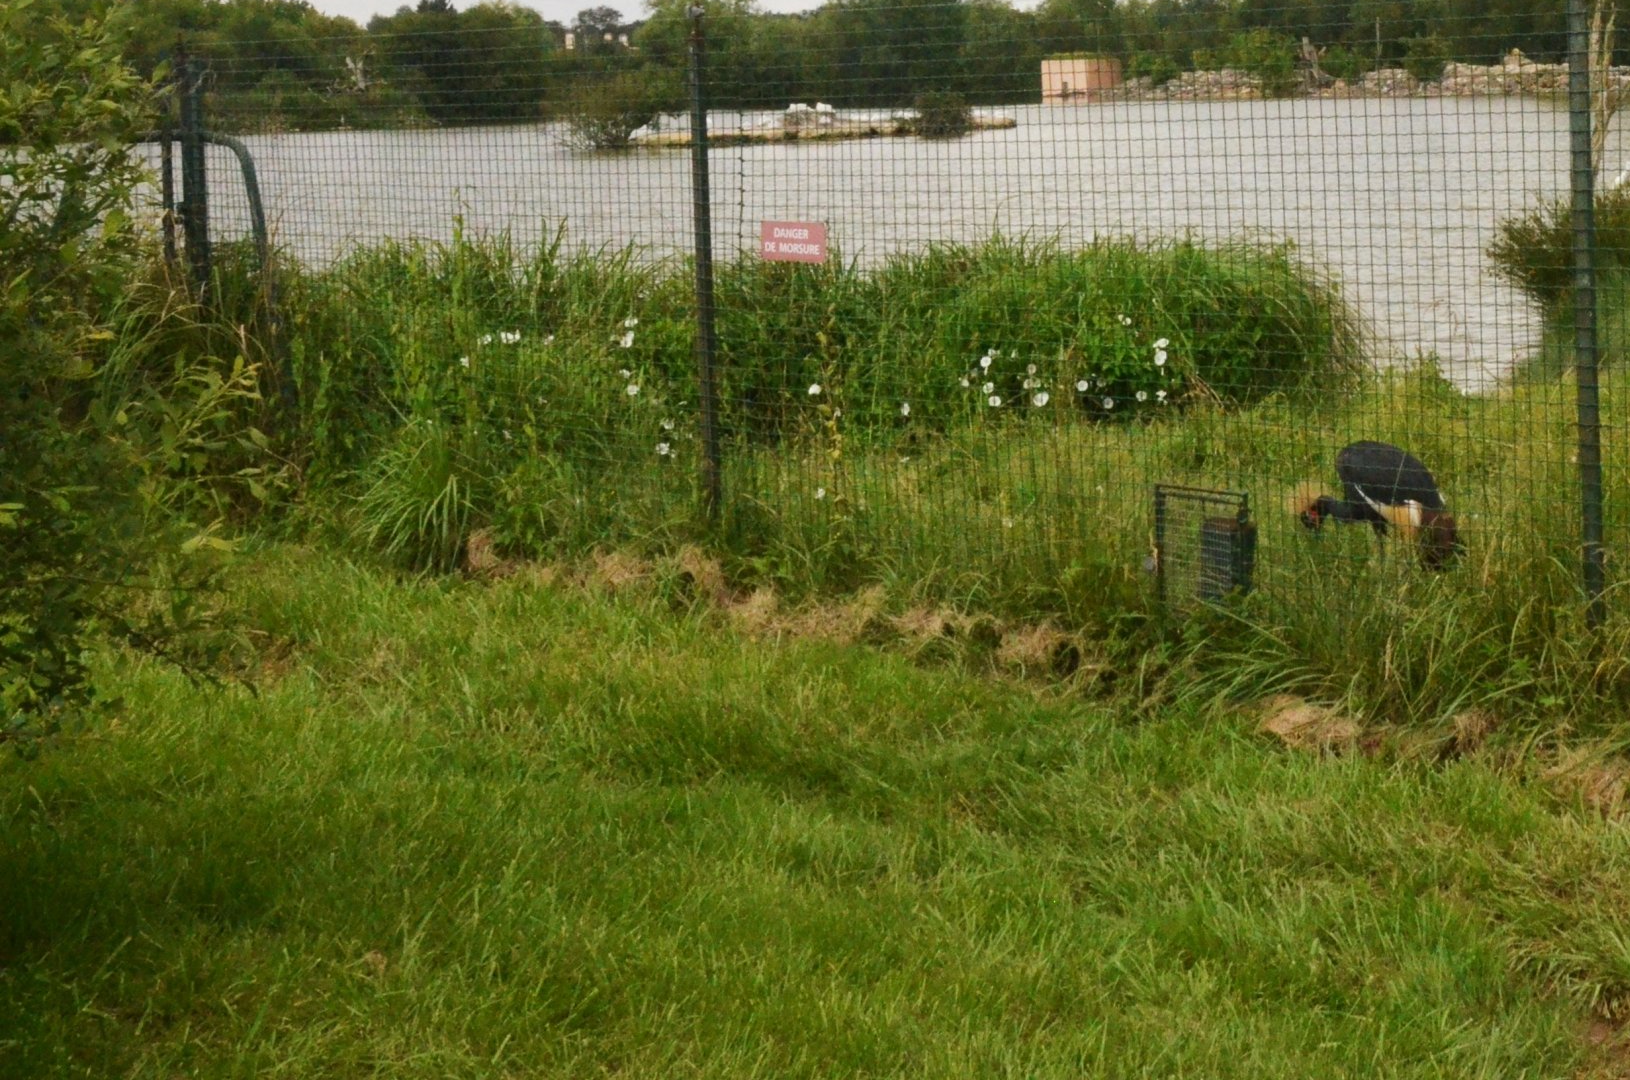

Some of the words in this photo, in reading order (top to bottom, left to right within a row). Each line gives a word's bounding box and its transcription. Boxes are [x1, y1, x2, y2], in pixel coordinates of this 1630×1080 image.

[774, 227, 809, 239] DANGER
[764, 242, 776, 253] DE
[779, 242, 821, 255] MORSURE
